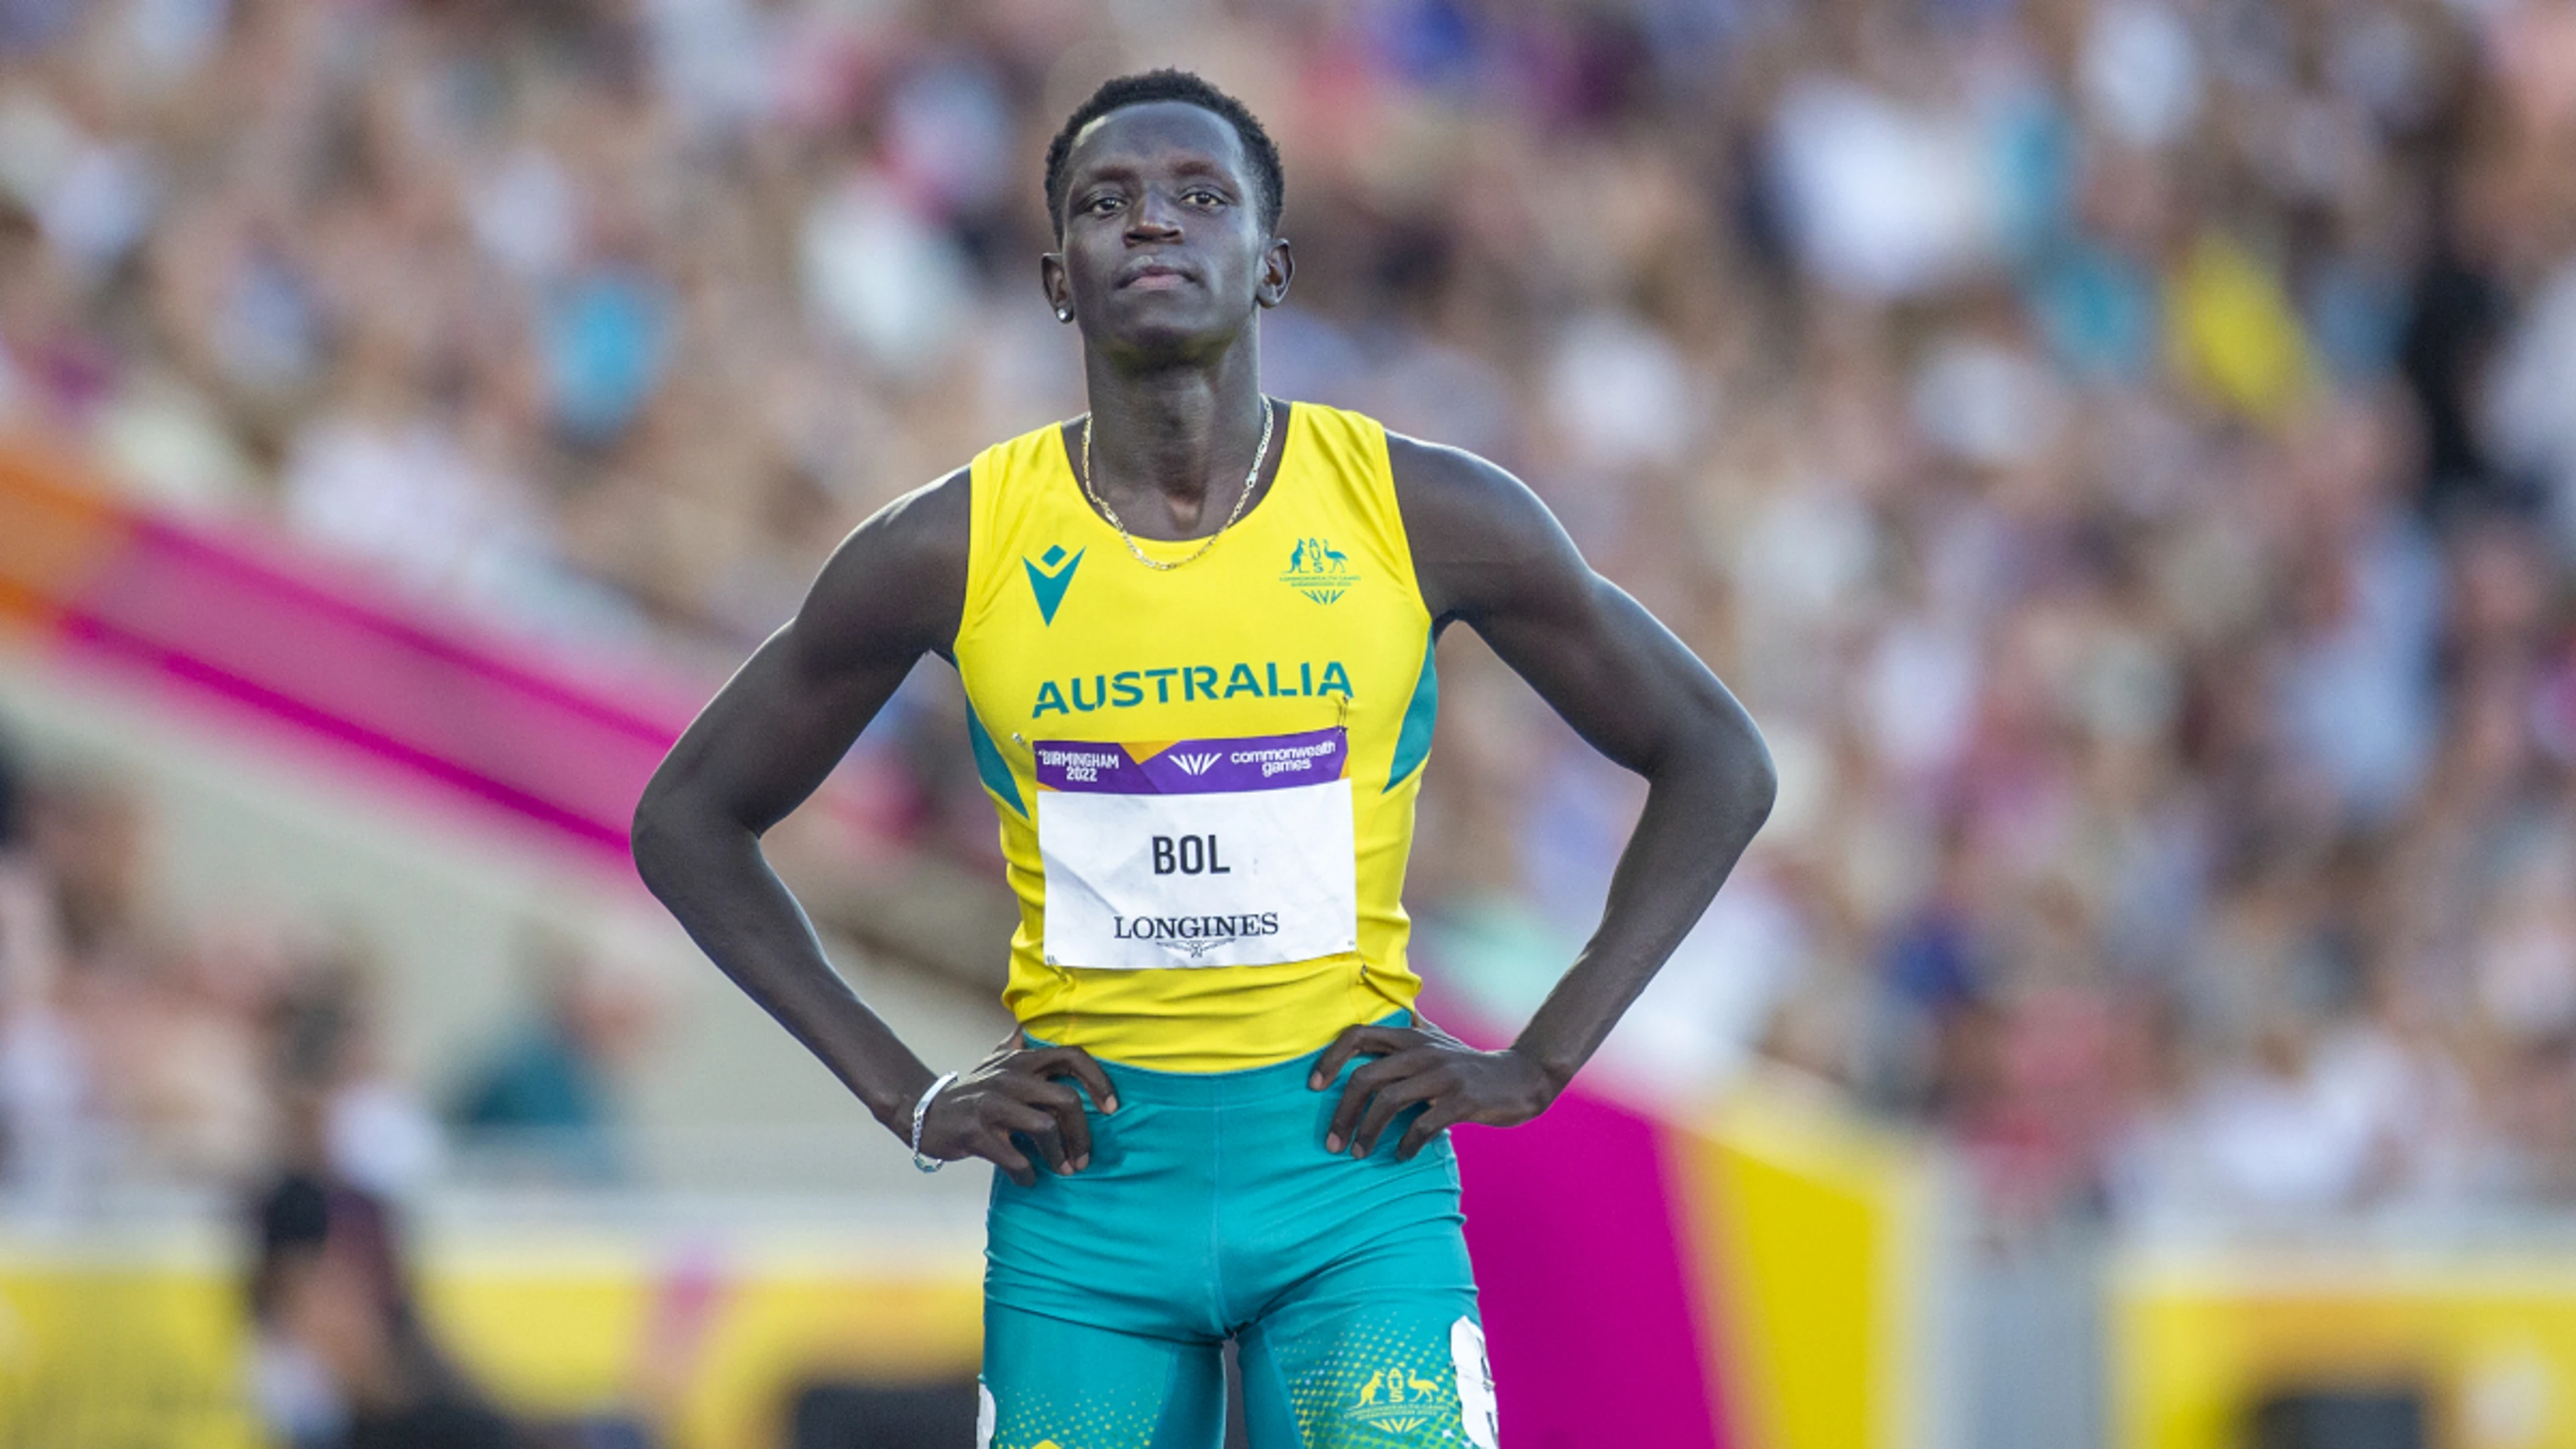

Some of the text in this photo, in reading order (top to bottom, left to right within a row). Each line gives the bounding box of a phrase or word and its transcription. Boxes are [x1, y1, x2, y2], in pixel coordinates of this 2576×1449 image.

[1032, 661, 1354, 718] AUSTRALIA
[1042, 750, 1119, 769] BIRMINGHAM
[1230, 741, 1336, 764] commonwealth
[1066, 766, 1097, 782] 2022
[1262, 759, 1311, 777] games
[1152, 835, 1230, 875] BOL
[1114, 912, 1279, 939] LONGINES
